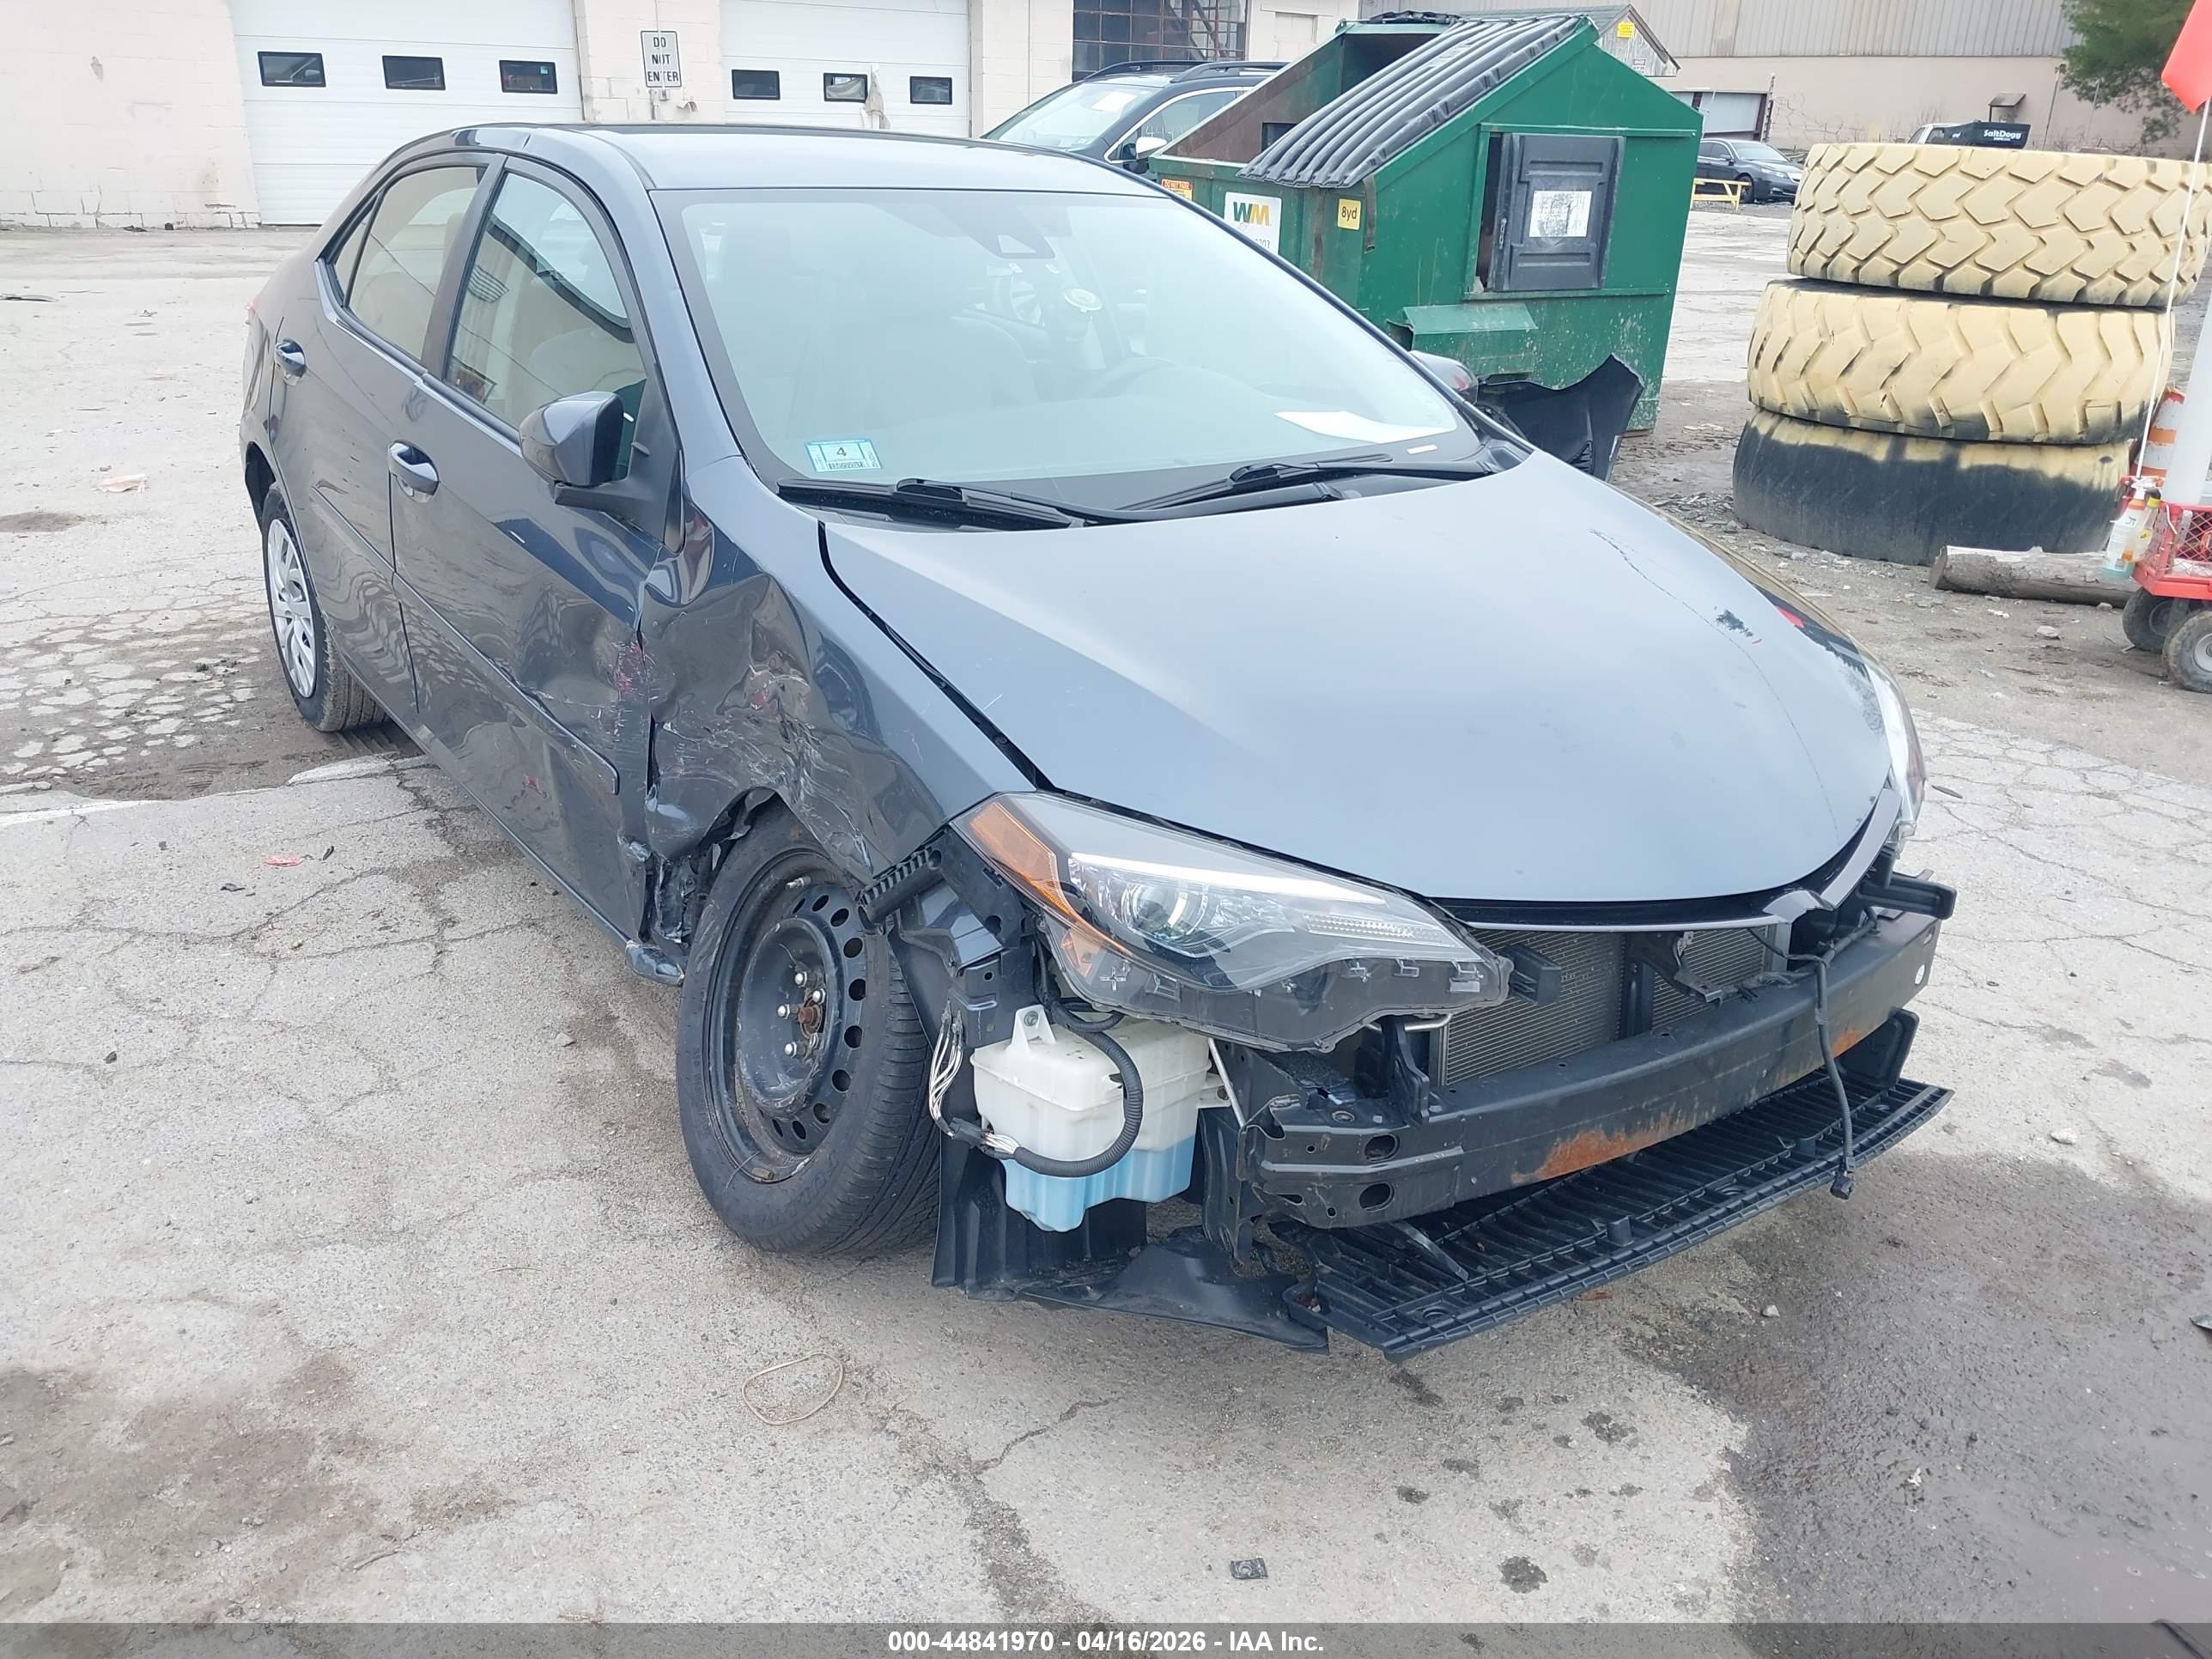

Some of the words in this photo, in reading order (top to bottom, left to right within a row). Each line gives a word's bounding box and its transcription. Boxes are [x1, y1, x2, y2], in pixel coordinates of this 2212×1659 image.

[653, 37, 666, 47] DO
[652, 54, 671, 64] NOT
[647, 71, 678, 82] ENTER
[1984, 130, 2021, 139] SaltDogg
[1233, 202, 1269, 226] WM
[1341, 205, 1358, 222] 8yd
